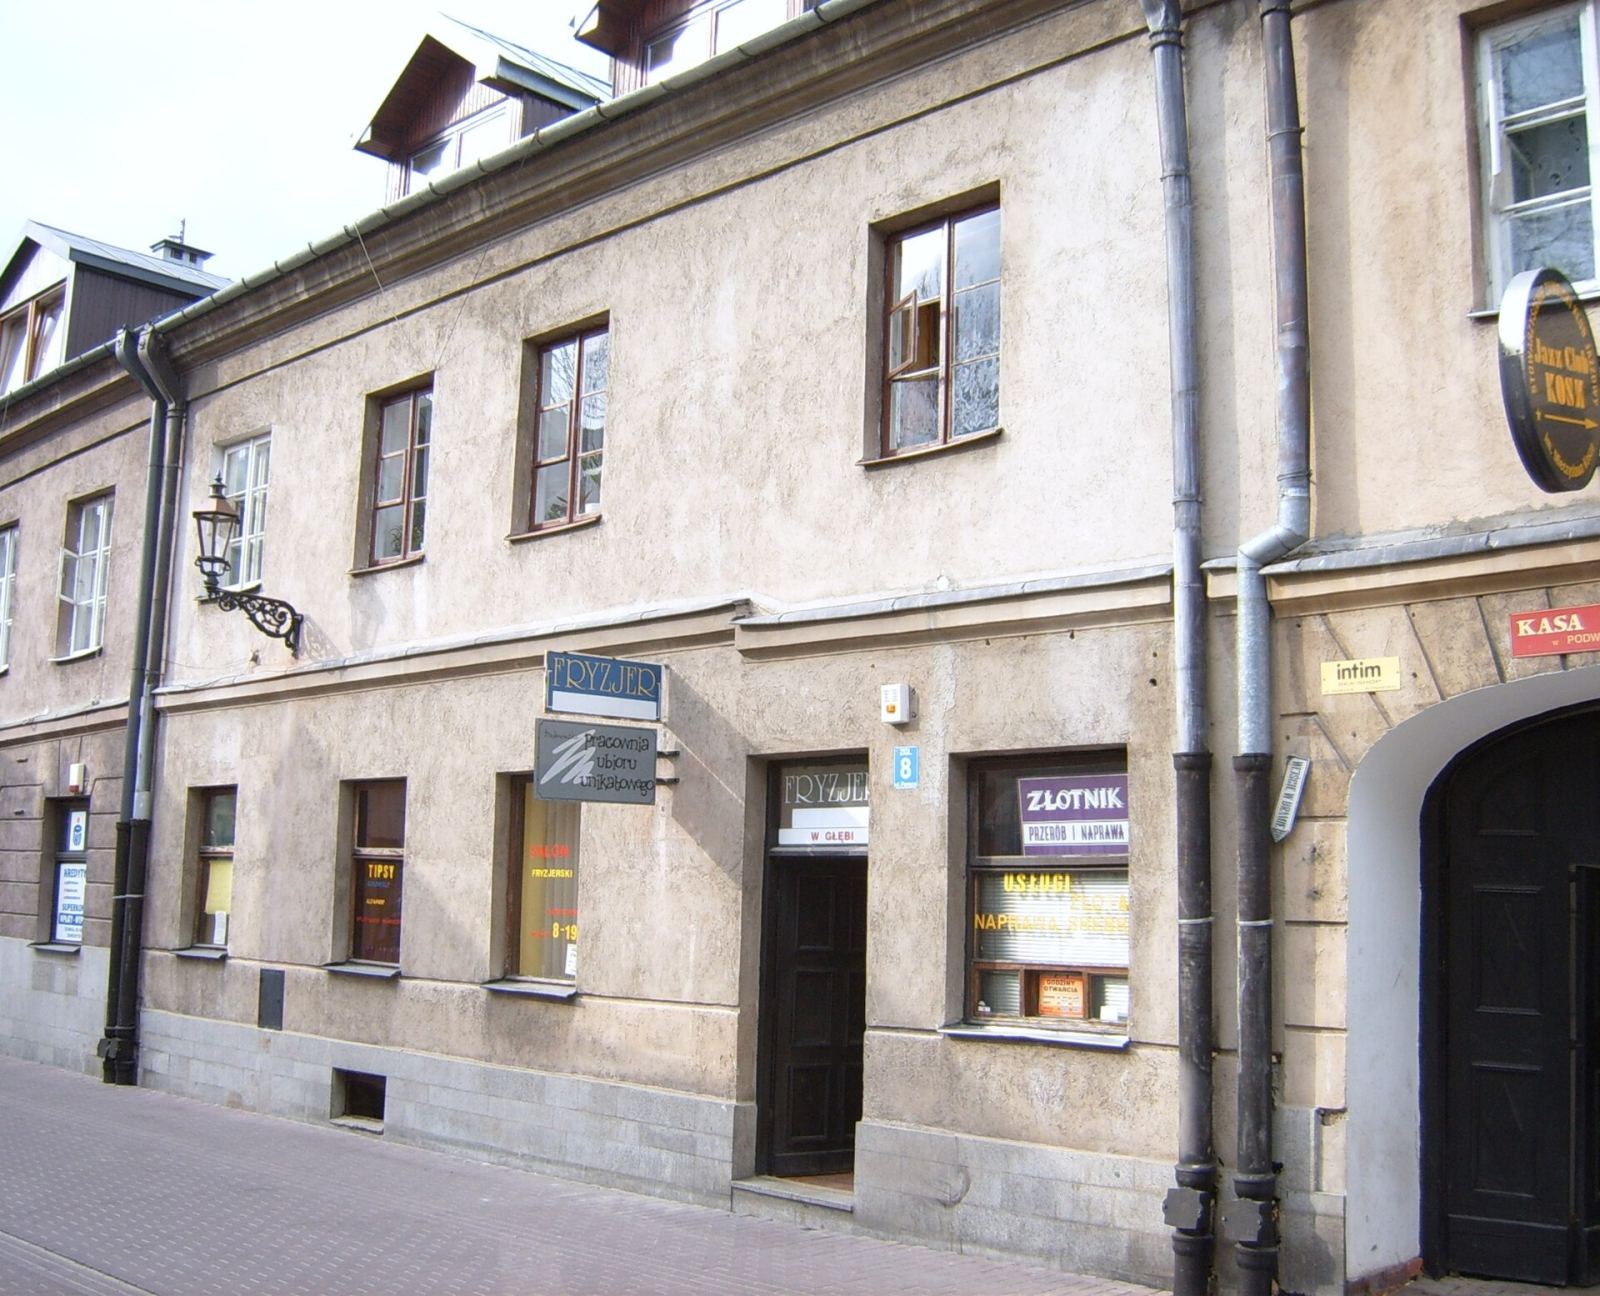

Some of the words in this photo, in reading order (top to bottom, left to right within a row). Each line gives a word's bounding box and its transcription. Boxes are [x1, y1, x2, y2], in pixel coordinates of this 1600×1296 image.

[1534, 338, 1562, 368] Jazz
[1516, 613, 1584, 637] KASA
[553, 656, 656, 698] FRYZJER
[1336, 661, 1382, 681] intim
[597, 754, 637, 770] ubioru
[900, 757, 912, 779] 8
[580, 774, 655, 797] unikatowego
[1027, 787, 1125, 811] ZŁOTNIK
[811, 831, 820, 841] W
[1081, 824, 1125, 841] NAPRAWA
[368, 864, 395, 880] TIPSY
[532, 869, 573, 878] FRYZJERSKI
[552, 922, 578, 941] 8-19
